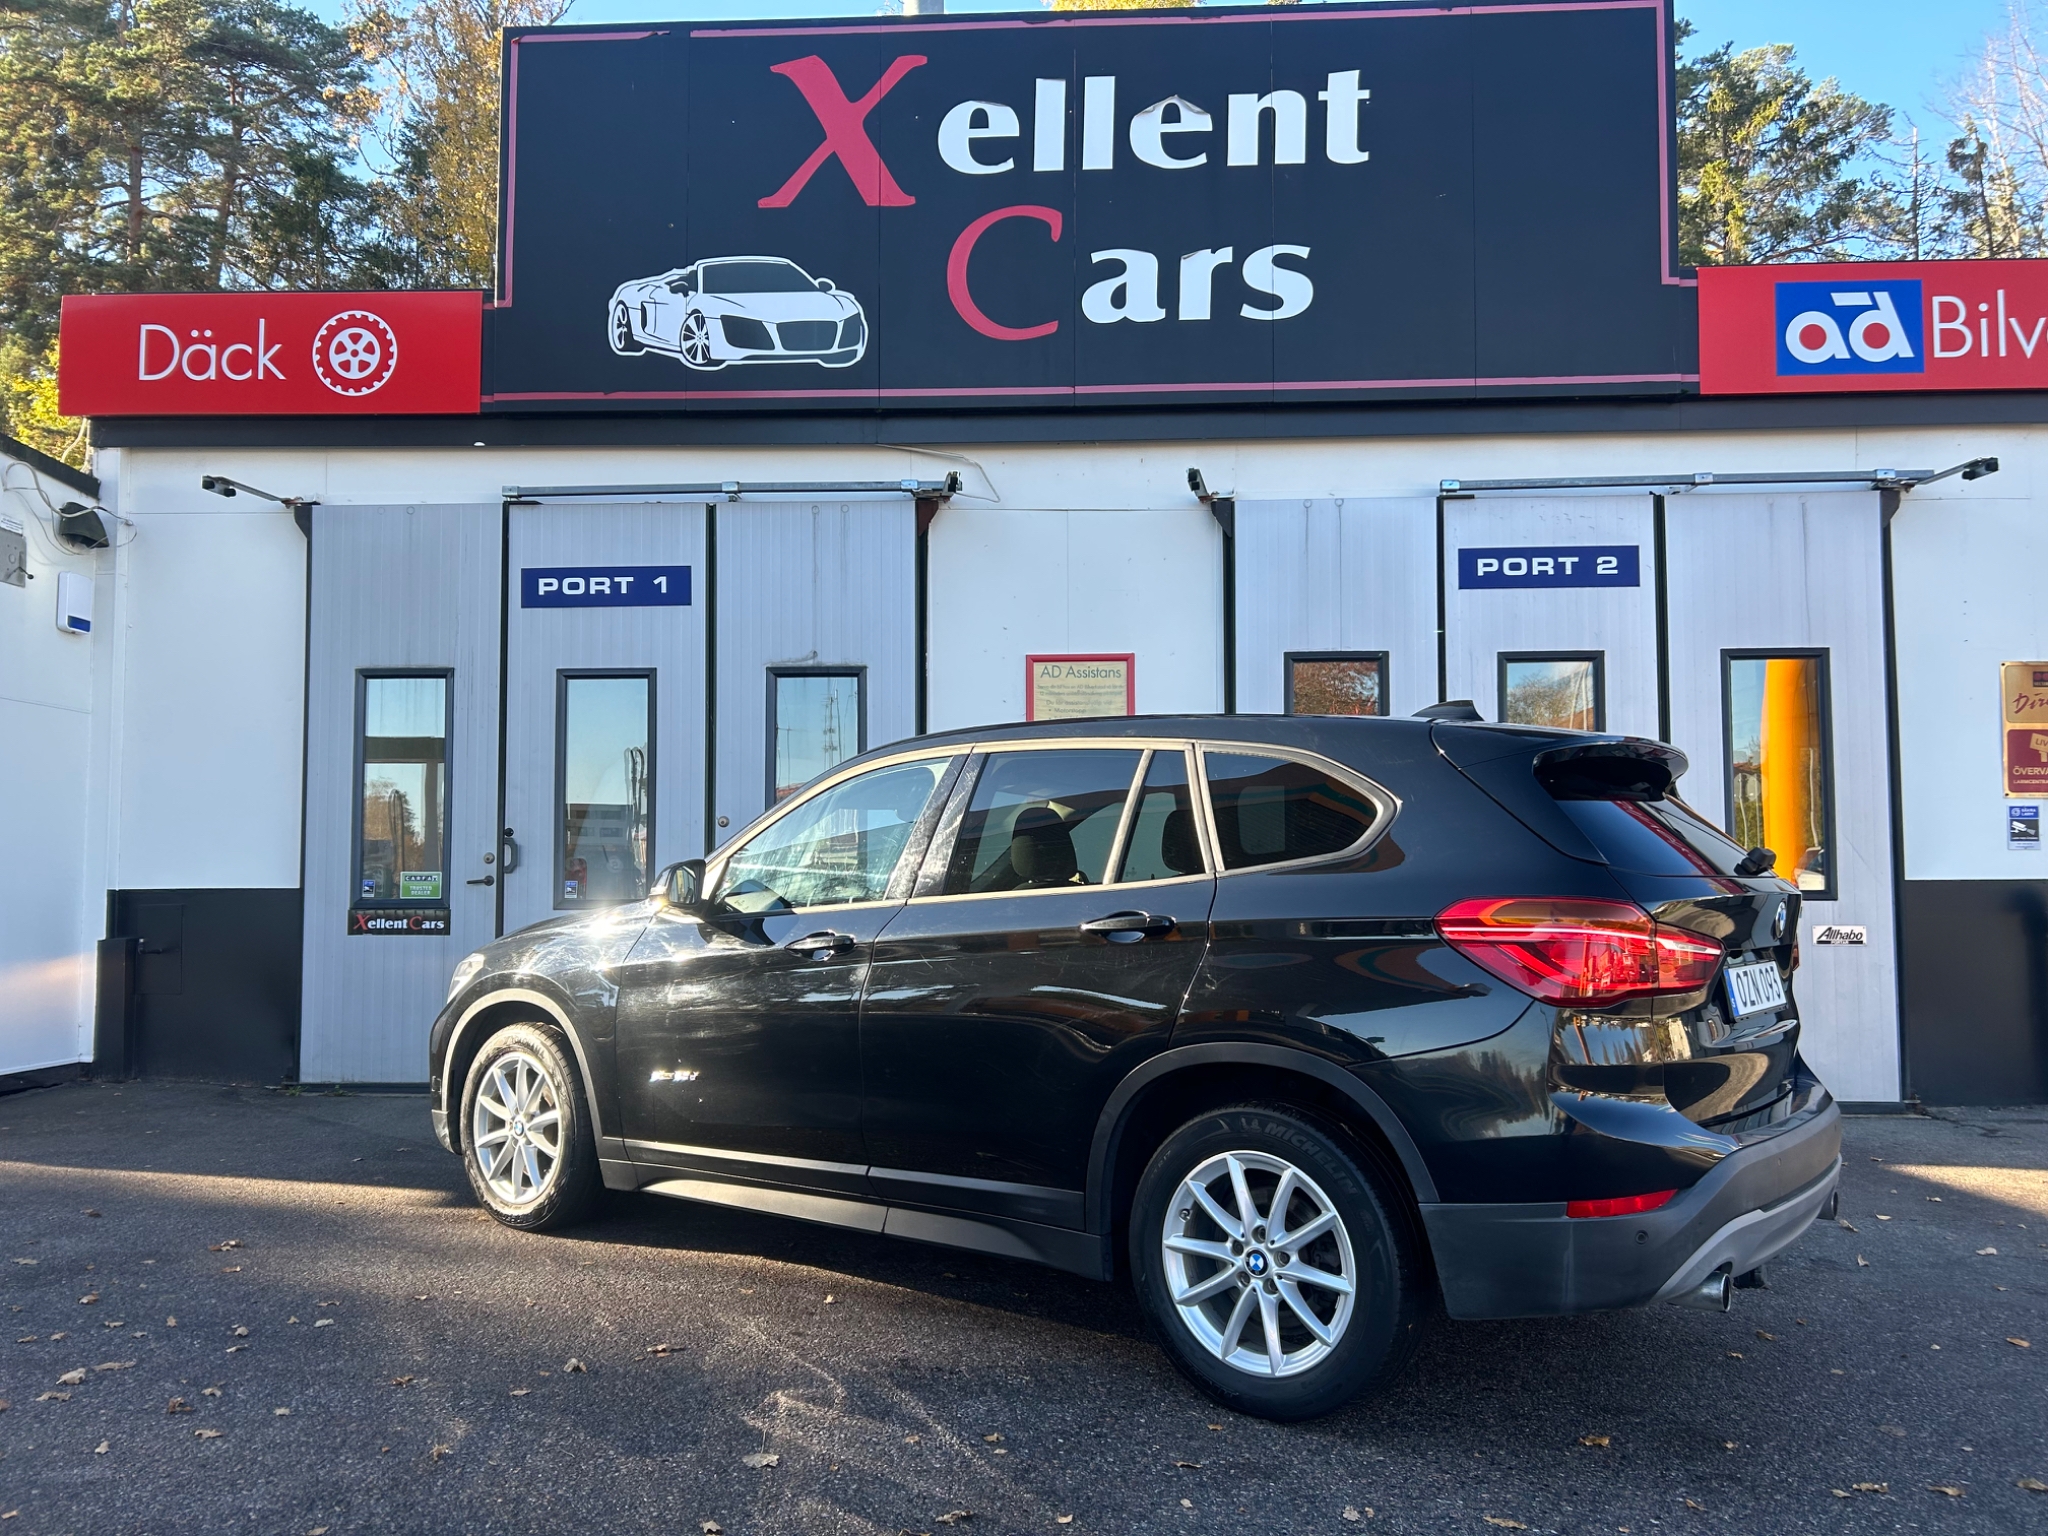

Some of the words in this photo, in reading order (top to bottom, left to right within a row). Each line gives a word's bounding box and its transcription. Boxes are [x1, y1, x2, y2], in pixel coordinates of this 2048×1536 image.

[757, 55, 1371, 207] Xellent
[947, 205, 1314, 340] Cars
[138, 318, 287, 381] Däck
[1932, 289, 2048, 359] Bilv
[538, 576, 635, 595] PORT
[653, 576, 667, 593] 1
[1477, 557, 1579, 576] PORT
[1596, 556, 1618, 575] 2
[1040, 665, 1062, 679] AD
[1065, 665, 1122, 679] Assistans
[1817, 927, 1864, 941] Allhabo
[1736, 969, 1763, 1008] OZN
[1263, 1121, 1360, 1195] MICHELIN
